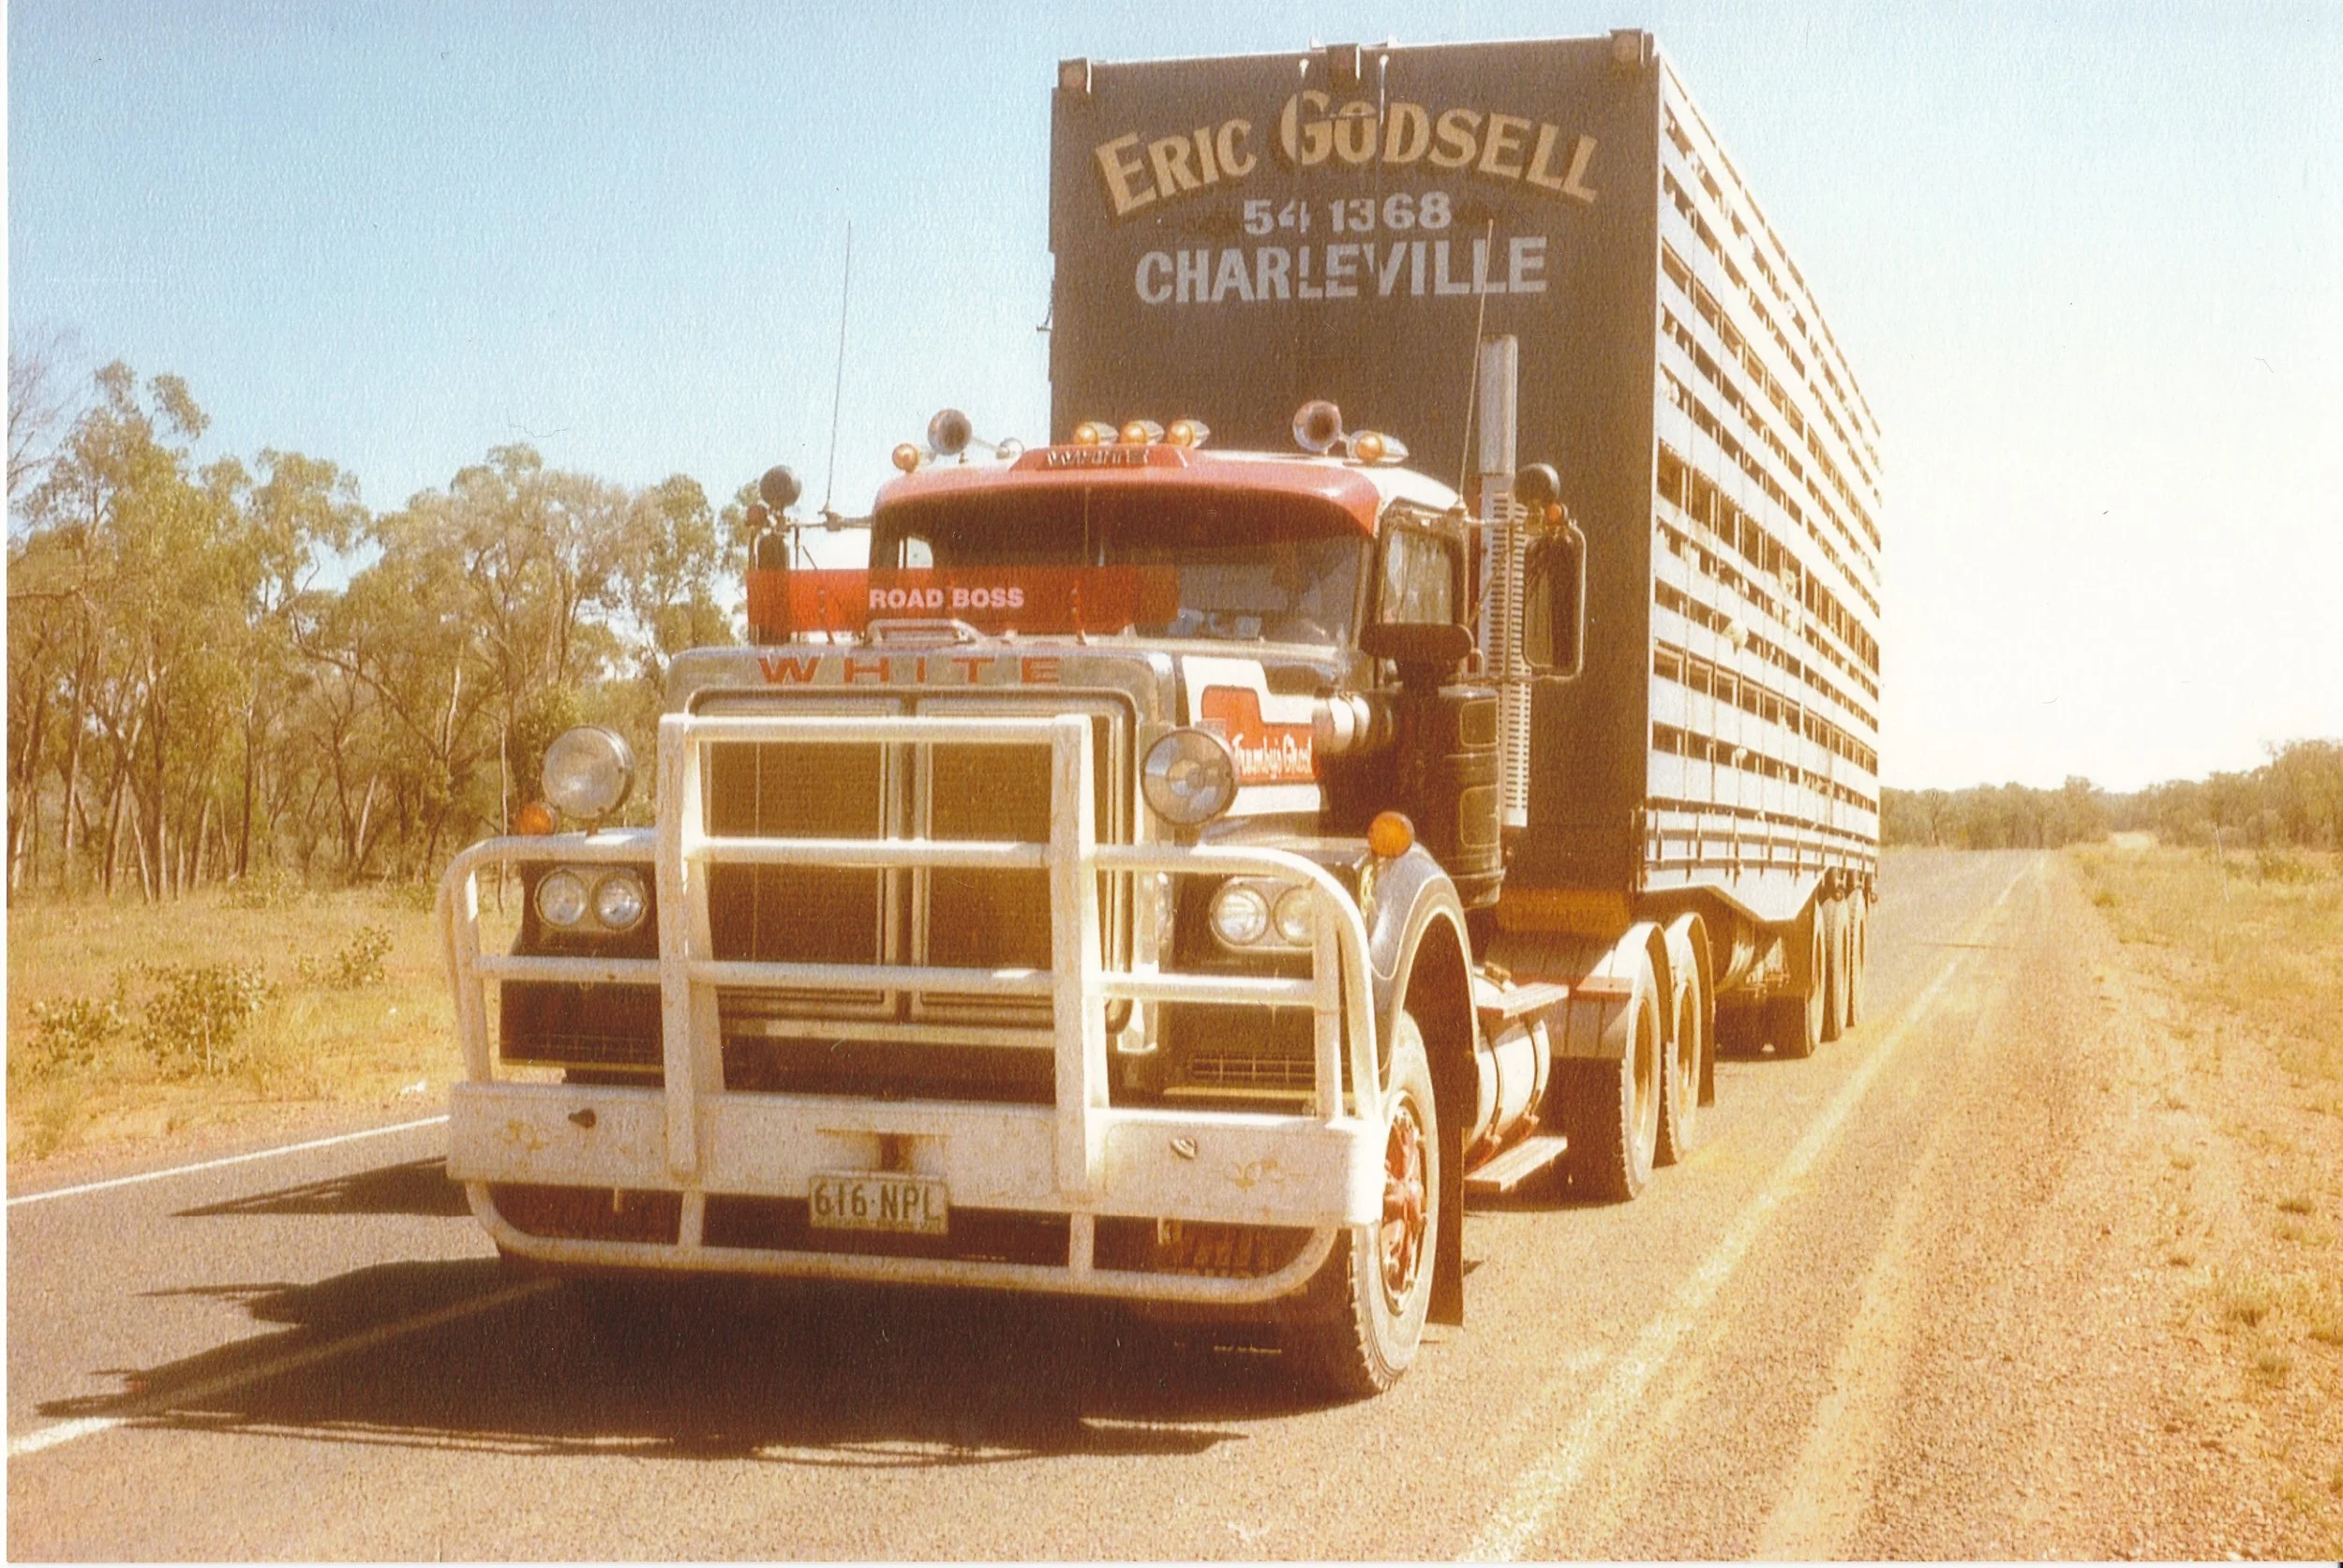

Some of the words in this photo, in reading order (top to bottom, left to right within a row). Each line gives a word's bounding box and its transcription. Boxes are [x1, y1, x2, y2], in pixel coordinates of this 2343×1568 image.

[1095, 118, 1257, 217] ERIC
[1280, 90, 1597, 203] GODSELL
[1243, 199, 1309, 235] 54
[1329, 191, 1452, 233] 1368
[1135, 237, 1547, 306] CHARLEVILLE
[869, 589, 944, 609] ROAD
[952, 588, 1024, 608] BOSS
[758, 655, 1062, 684] WHITE
